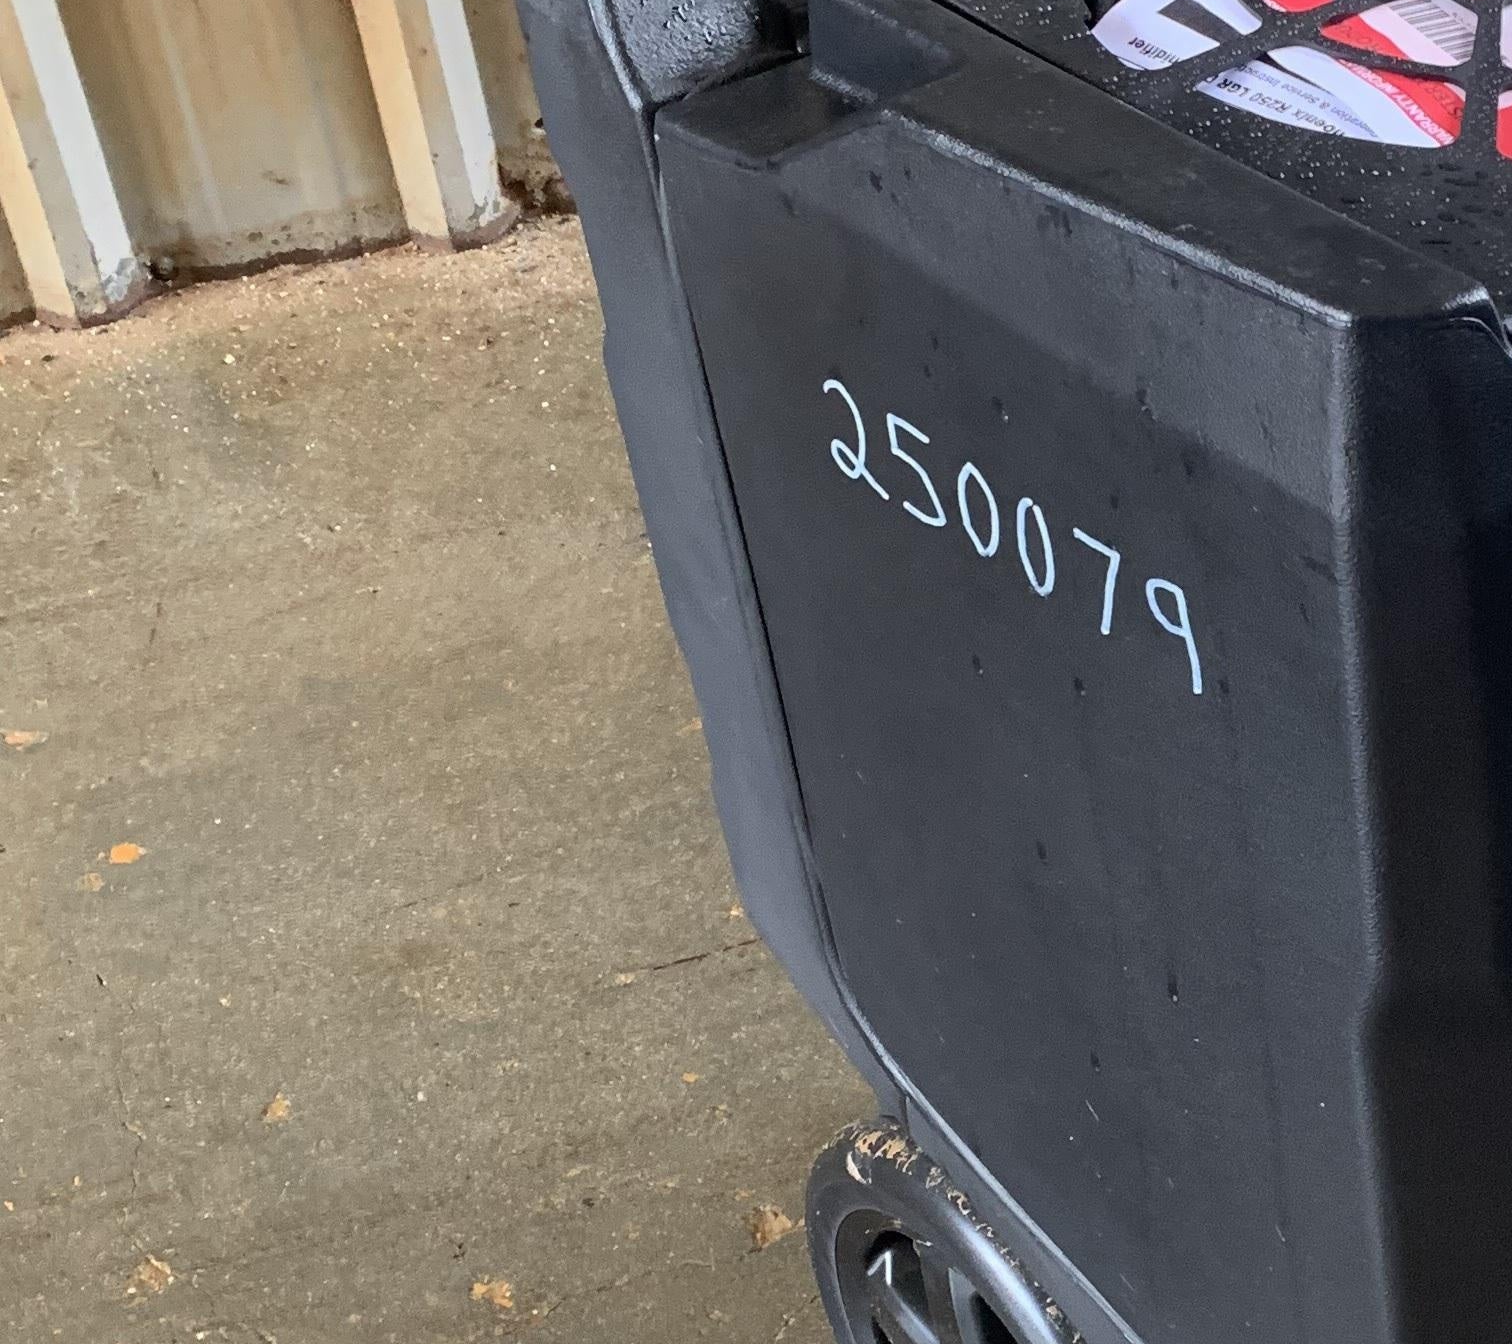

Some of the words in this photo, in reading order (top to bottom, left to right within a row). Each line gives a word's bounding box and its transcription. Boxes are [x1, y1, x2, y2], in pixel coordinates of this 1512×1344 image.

[1216, 78, 1245, 98] LGR
[1251, 92, 1294, 114] R250
[822, 378, 1203, 695] 250079
